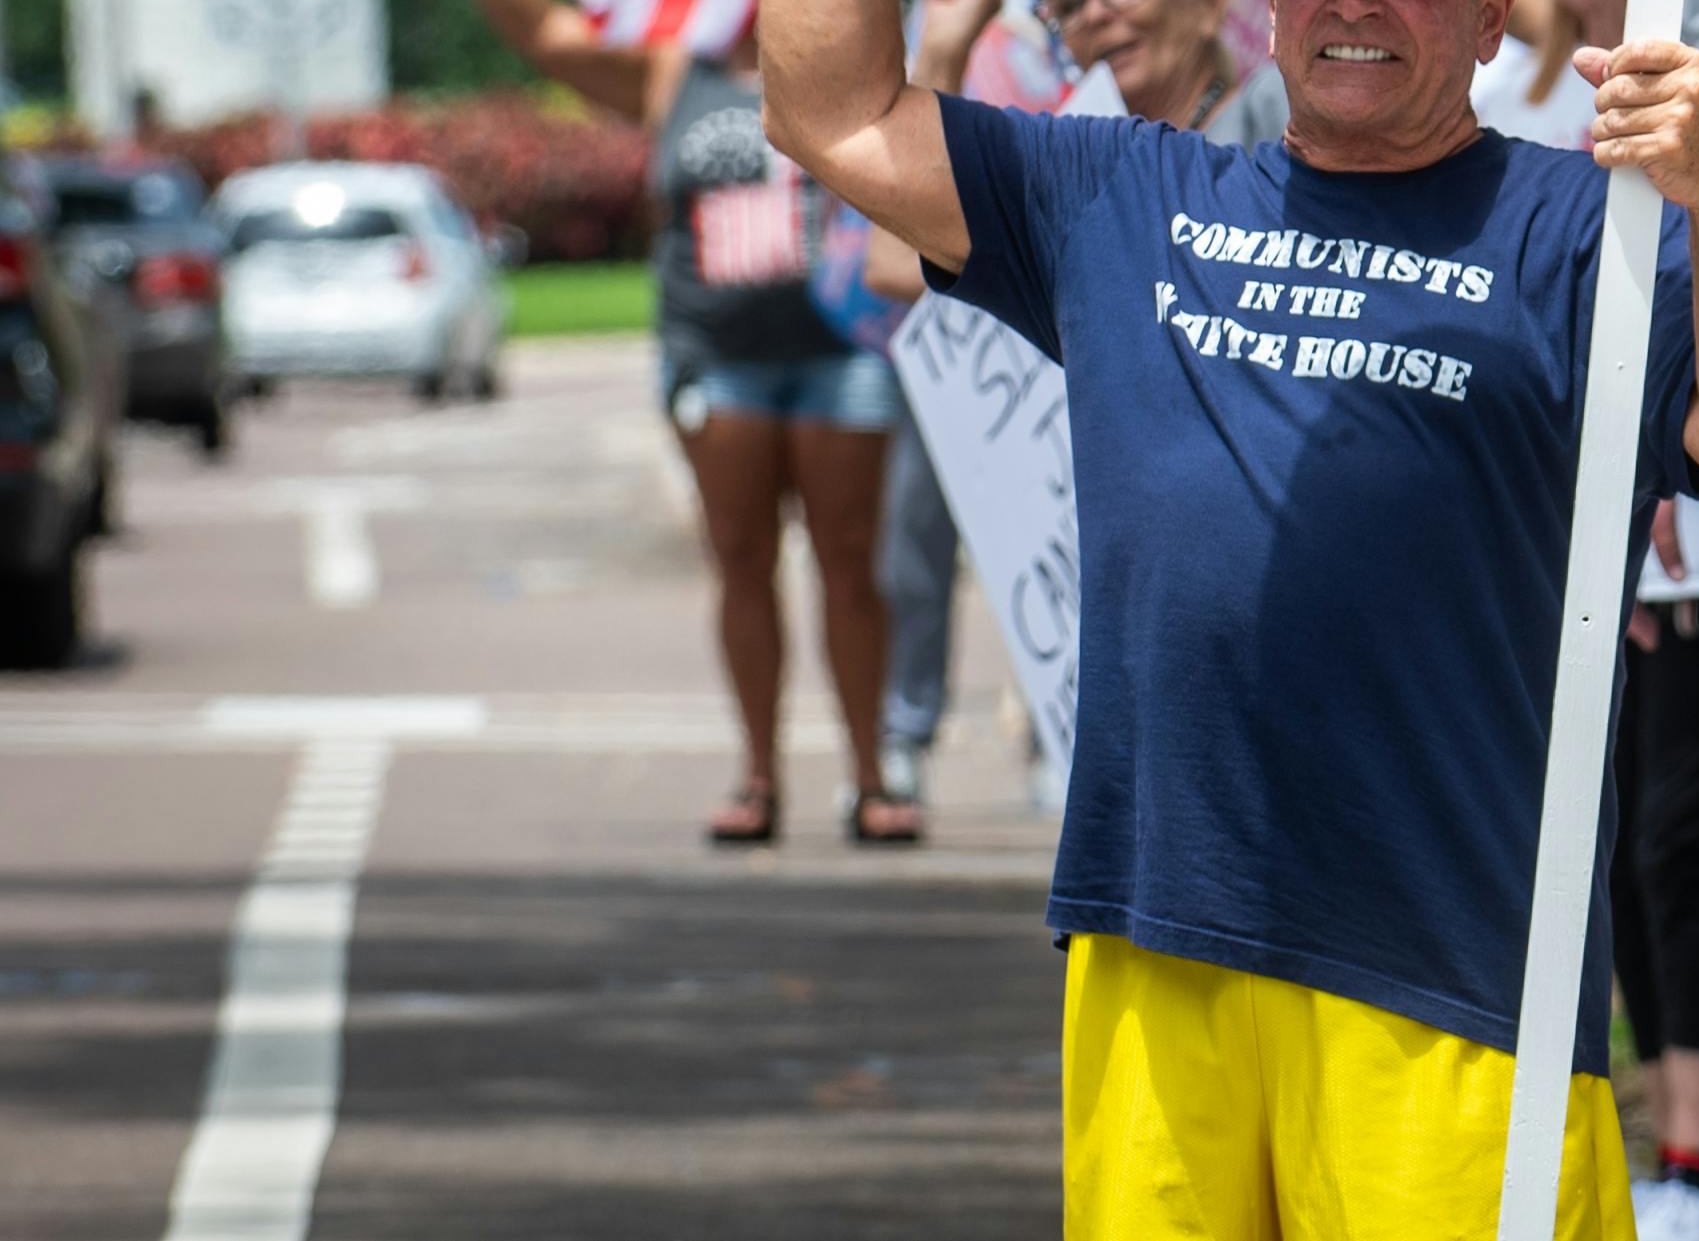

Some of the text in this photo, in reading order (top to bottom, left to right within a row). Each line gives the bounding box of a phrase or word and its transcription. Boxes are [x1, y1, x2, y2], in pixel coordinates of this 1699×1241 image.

[1171, 212, 1494, 303] COMMUNISTS
[1237, 281, 1367, 319] IN THE
[1292, 336, 1473, 402] HOUSE
